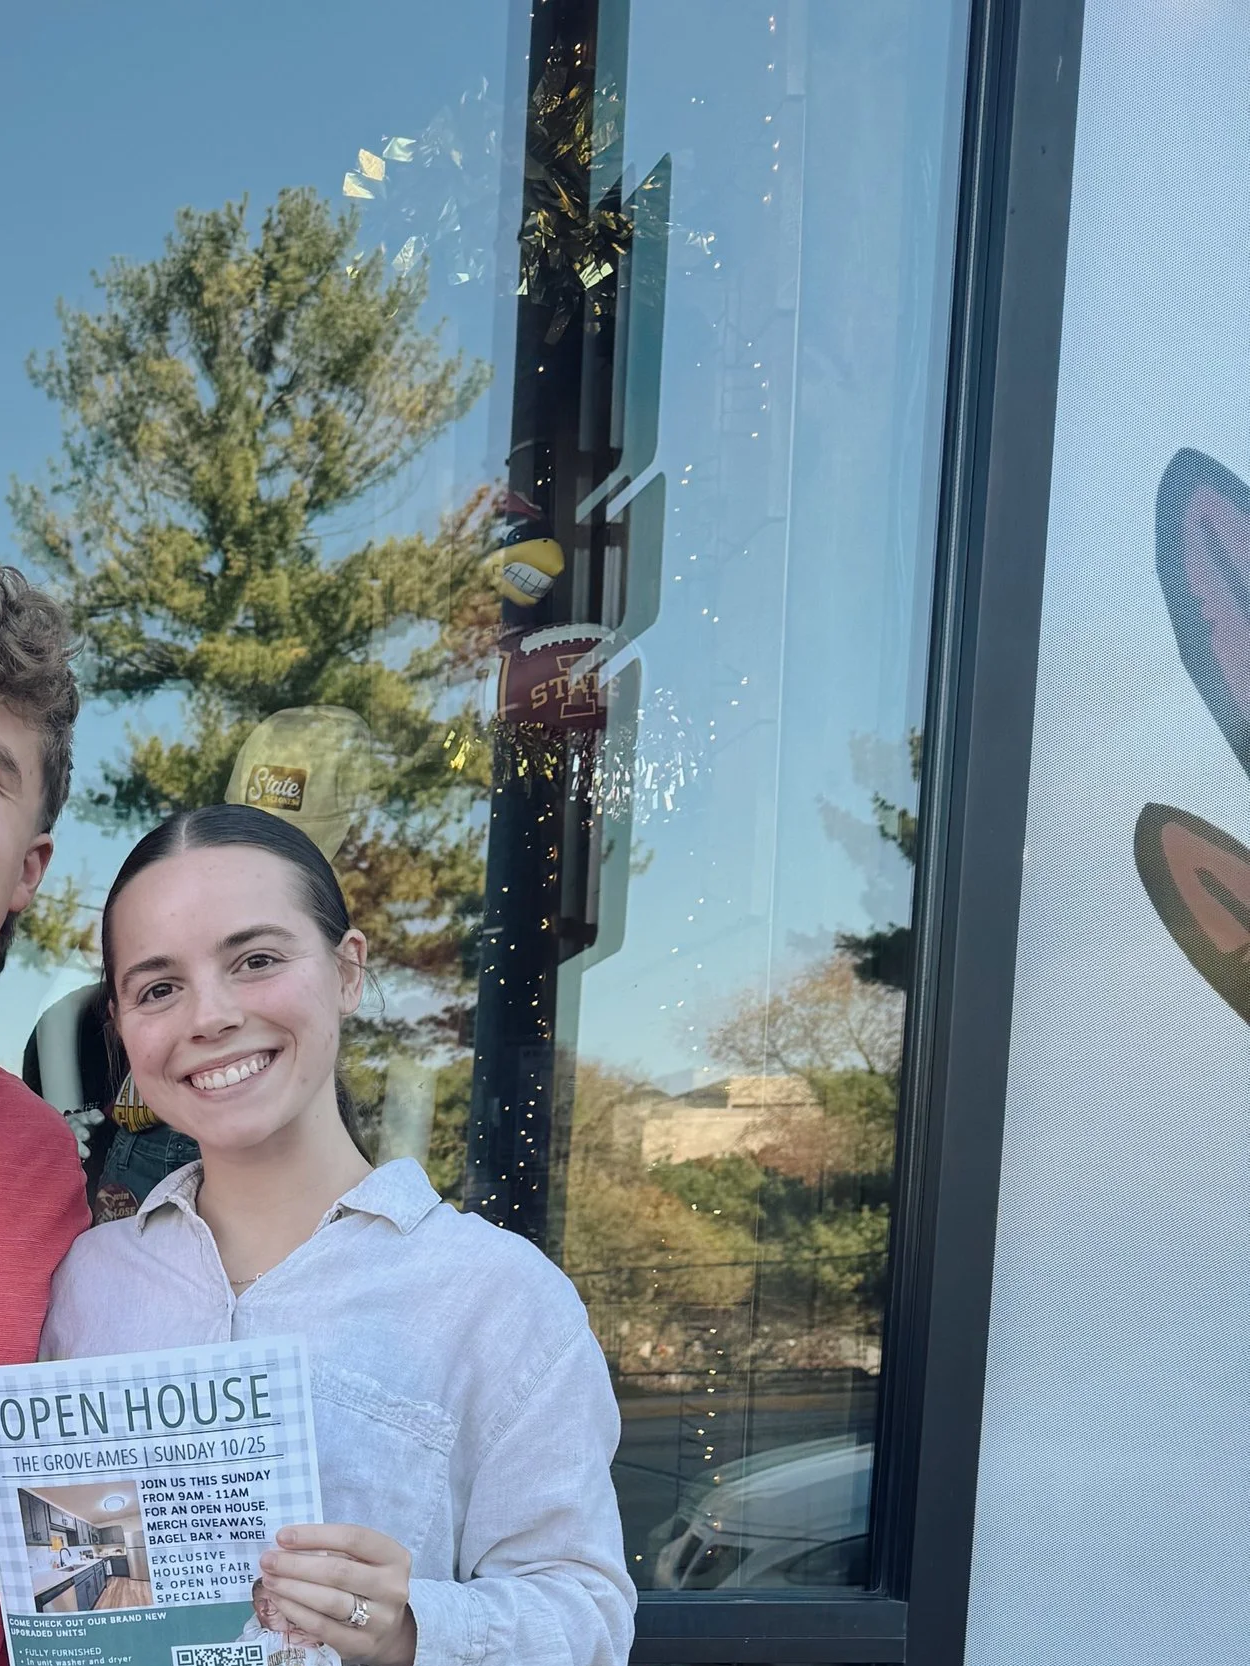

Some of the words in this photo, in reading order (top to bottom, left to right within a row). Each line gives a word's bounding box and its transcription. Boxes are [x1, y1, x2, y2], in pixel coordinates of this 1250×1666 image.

[248, 767, 301, 801] State
[1, 1392, 108, 1441] OPEN
[125, 1374, 271, 1431] HOUSE
[13, 1456, 40, 1472] THE
[44, 1452, 94, 1470] GROVE
[97, 1448, 138, 1467] AMES
[154, 1440, 215, 1462] SUNDAY
[220, 1435, 266, 1457] 10/25
[141, 1479, 167, 1489] JOIN
[171, 1478, 186, 1487] US
[190, 1476, 217, 1486] THIS
[222, 1470, 270, 1484] SUNDAY
[143, 1493, 175, 1503] FROM
[178, 1491, 204, 1501] 9AM
[216, 1488, 249, 1499] 11AM
[145, 1507, 167, 1517] FOR
[171, 1505, 187, 1515] AN
[191, 1505, 221, 1514] OPEN
[225, 1501, 268, 1513] HOUSE,
[147, 1520, 187, 1531] MERCH
[192, 1516, 266, 1527] GIVEAWAYS,
[149, 1534, 186, 1545] BAGEL
[190, 1532, 213, 1541] BAR
[230, 1531, 265, 1540] MORE!
[152, 1551, 226, 1564] EXCLUSIVE
[154, 1565, 213, 1577] HOUSING
[221, 1562, 250, 1572] FAIR
[156, 1582, 163, 1590] &
[170, 1579, 204, 1588] OPEN
[211, 1575, 254, 1585] HOUSE
[157, 1590, 221, 1603] SPECIALS
[9, 1618, 31, 1627] COME
[34, 1619, 63, 1627] CHECK
[66, 1619, 84, 1627] OUT
[88, 1617, 106, 1626] OUR
[110, 1614, 141, 1624] BRAND
[146, 1612, 167, 1621] NEW
[11, 1629, 52, 1637] UPGRADED
[25, 1649, 48, 1657] FULLY
[52, 1648, 101, 1657] FURNISHED
[37, 1658, 52, 1666] unit
[56, 1658, 85, 1666] washer
[90, 1656, 104, 1664] and
[109, 1656, 132, 1665] dryer
